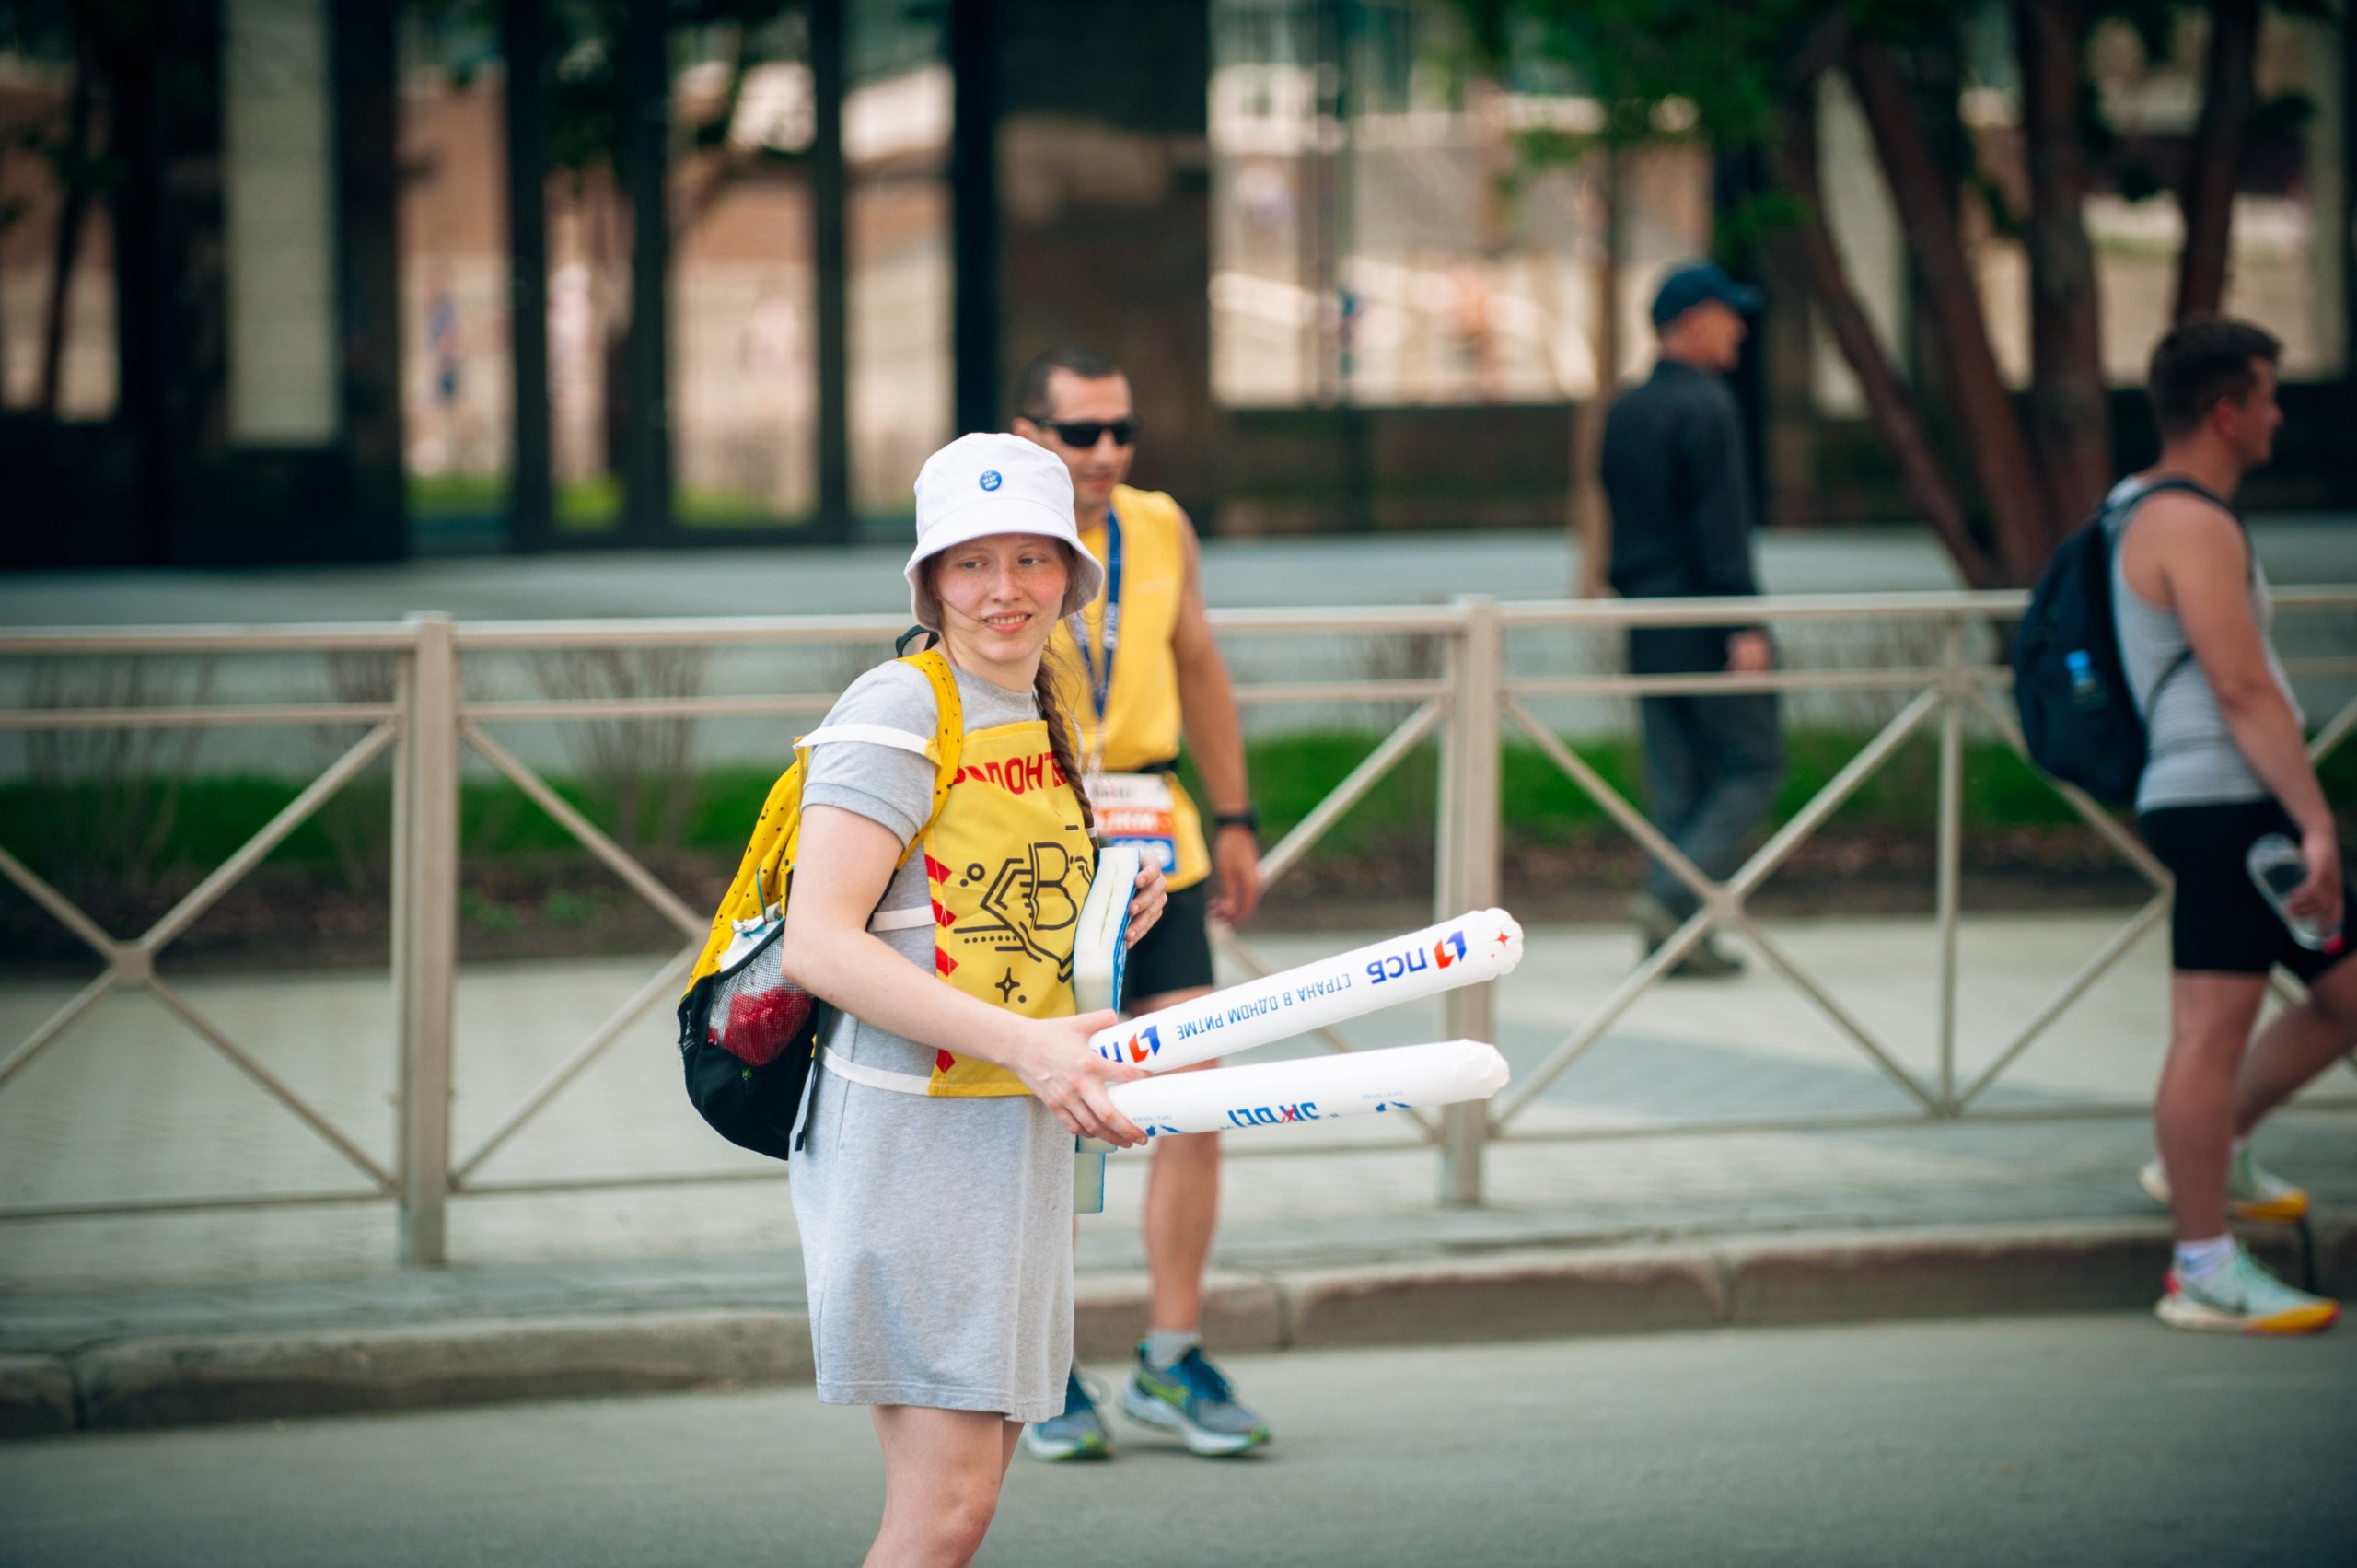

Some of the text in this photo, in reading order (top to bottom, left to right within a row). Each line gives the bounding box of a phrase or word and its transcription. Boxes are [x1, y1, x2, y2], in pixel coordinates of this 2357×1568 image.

[1365, 947, 1429, 985] ПСБ
[1175, 972, 1353, 1040] СТРАНА В ОДНОМ РИТМЕ
